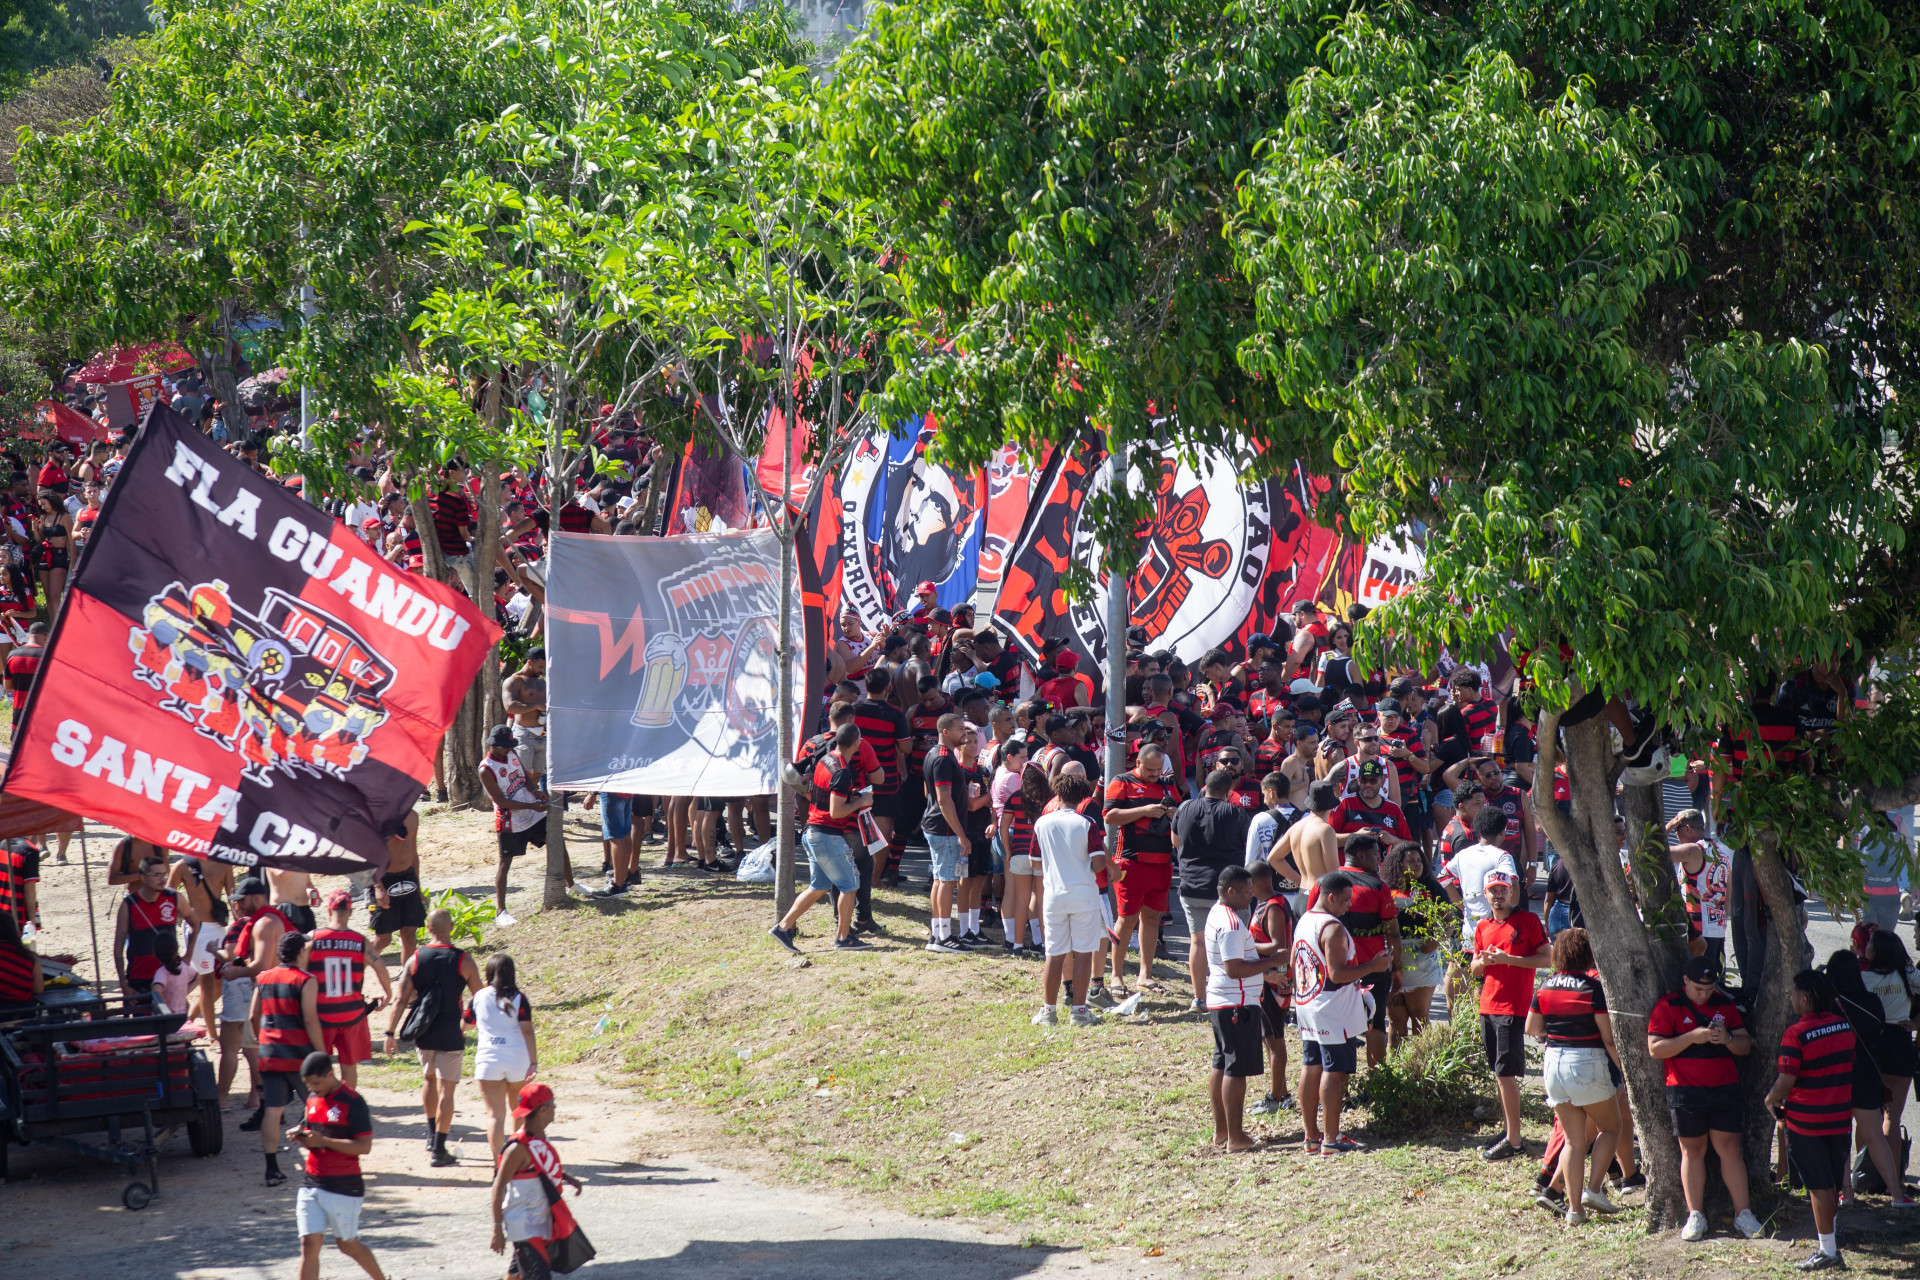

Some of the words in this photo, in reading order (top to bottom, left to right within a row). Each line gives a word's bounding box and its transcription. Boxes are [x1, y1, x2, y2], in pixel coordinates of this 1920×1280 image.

[164, 440, 262, 541] FLA
[267, 516, 471, 651] GUANDU
[51, 718, 243, 834] SANTA
[316, 939, 332, 950] FLA
[1555, 976, 1587, 989] MRV
